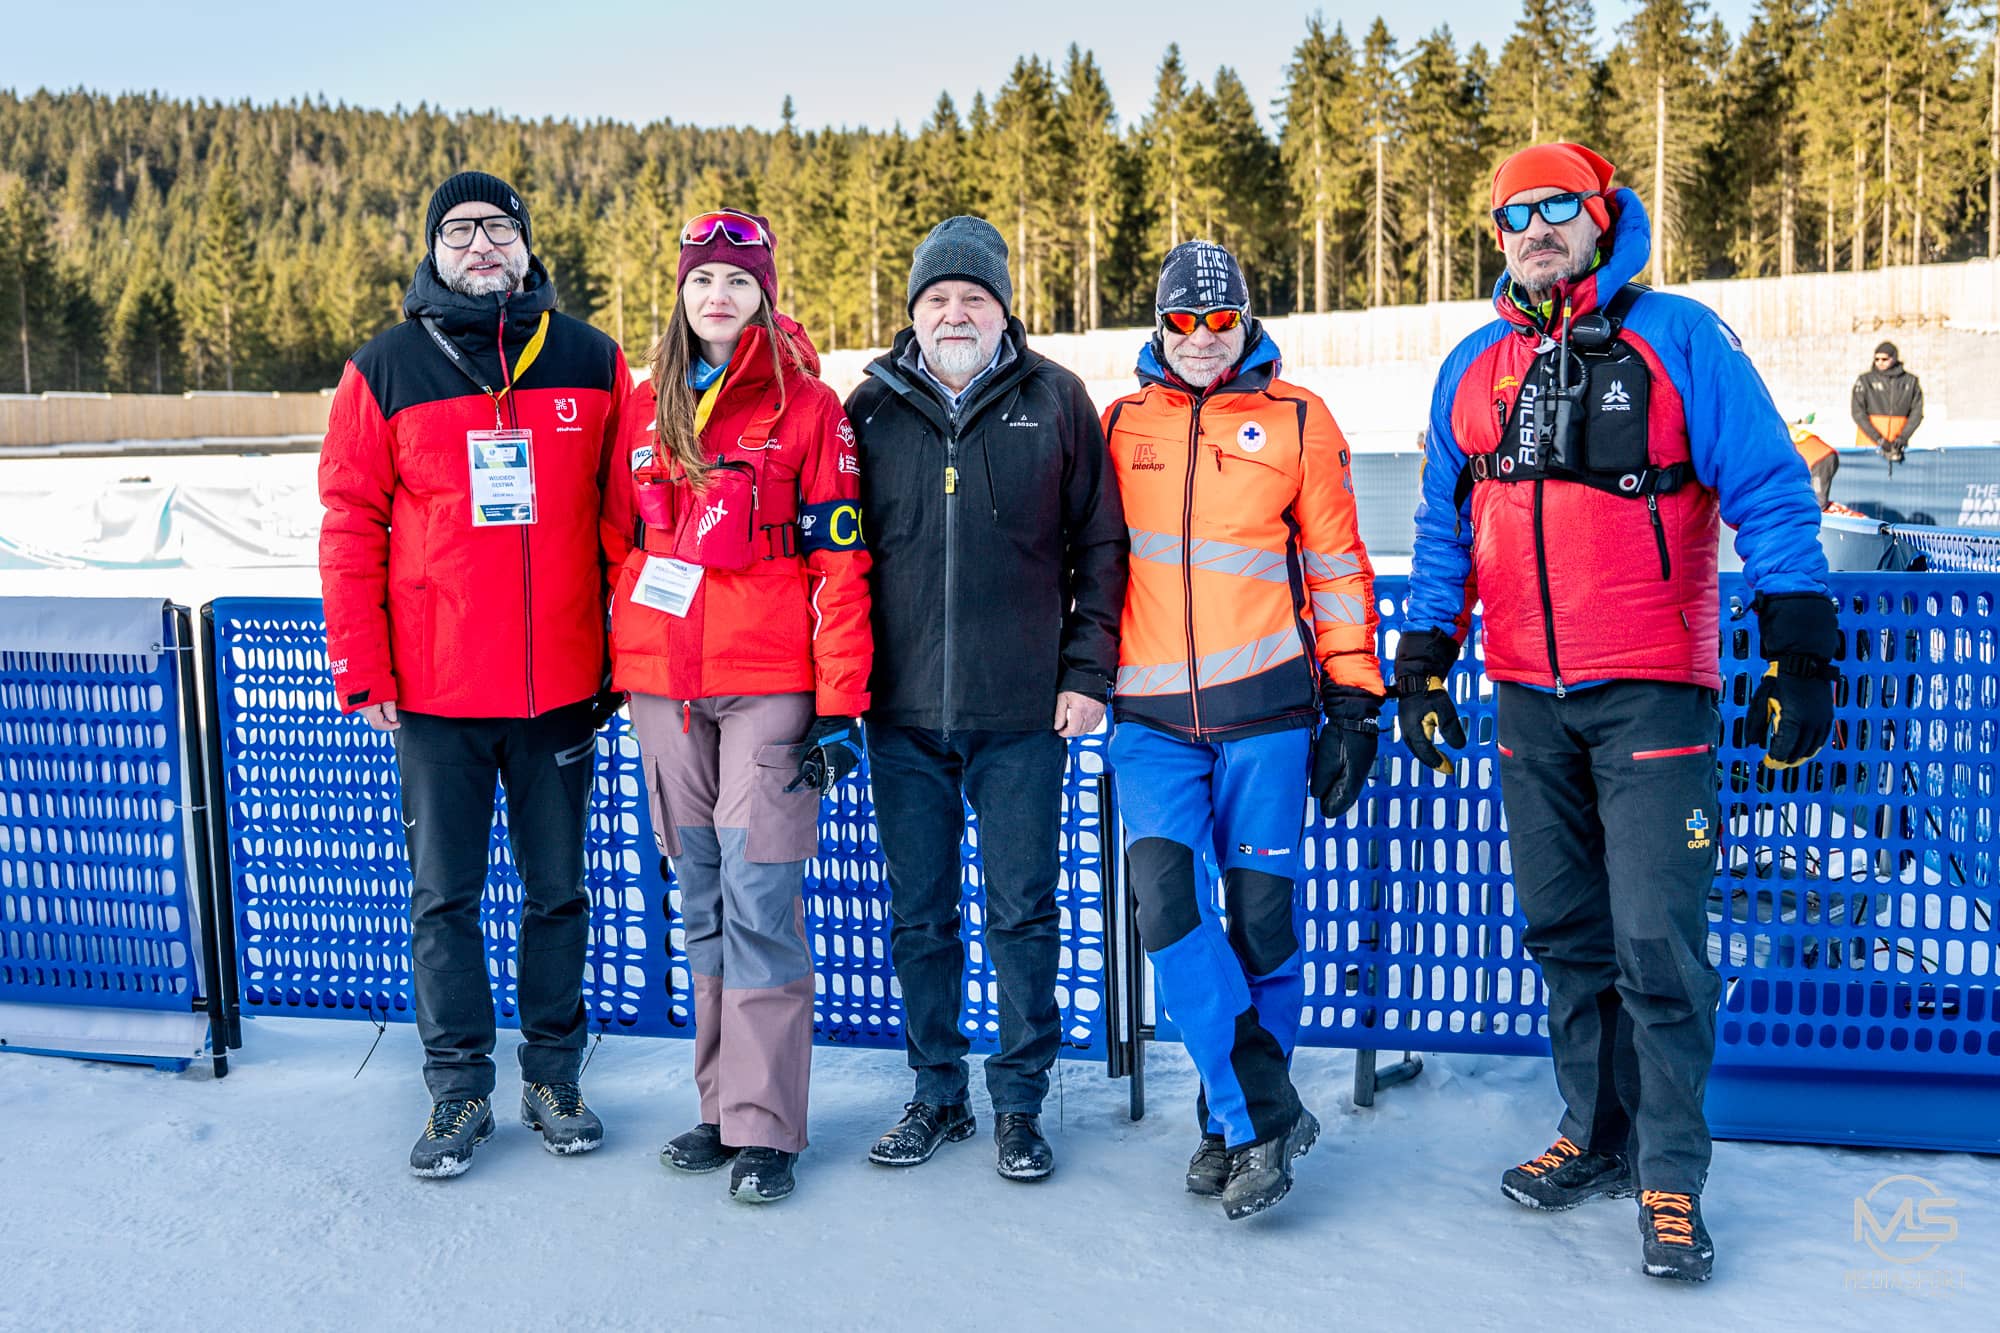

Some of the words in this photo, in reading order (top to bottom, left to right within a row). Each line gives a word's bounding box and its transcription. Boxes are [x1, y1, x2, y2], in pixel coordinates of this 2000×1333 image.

[1132, 462, 1165, 472] InterApp
[1966, 484, 2000, 498] THE
[1957, 511, 2000, 527] FAM
[1687, 839, 1711, 849] GOPR
